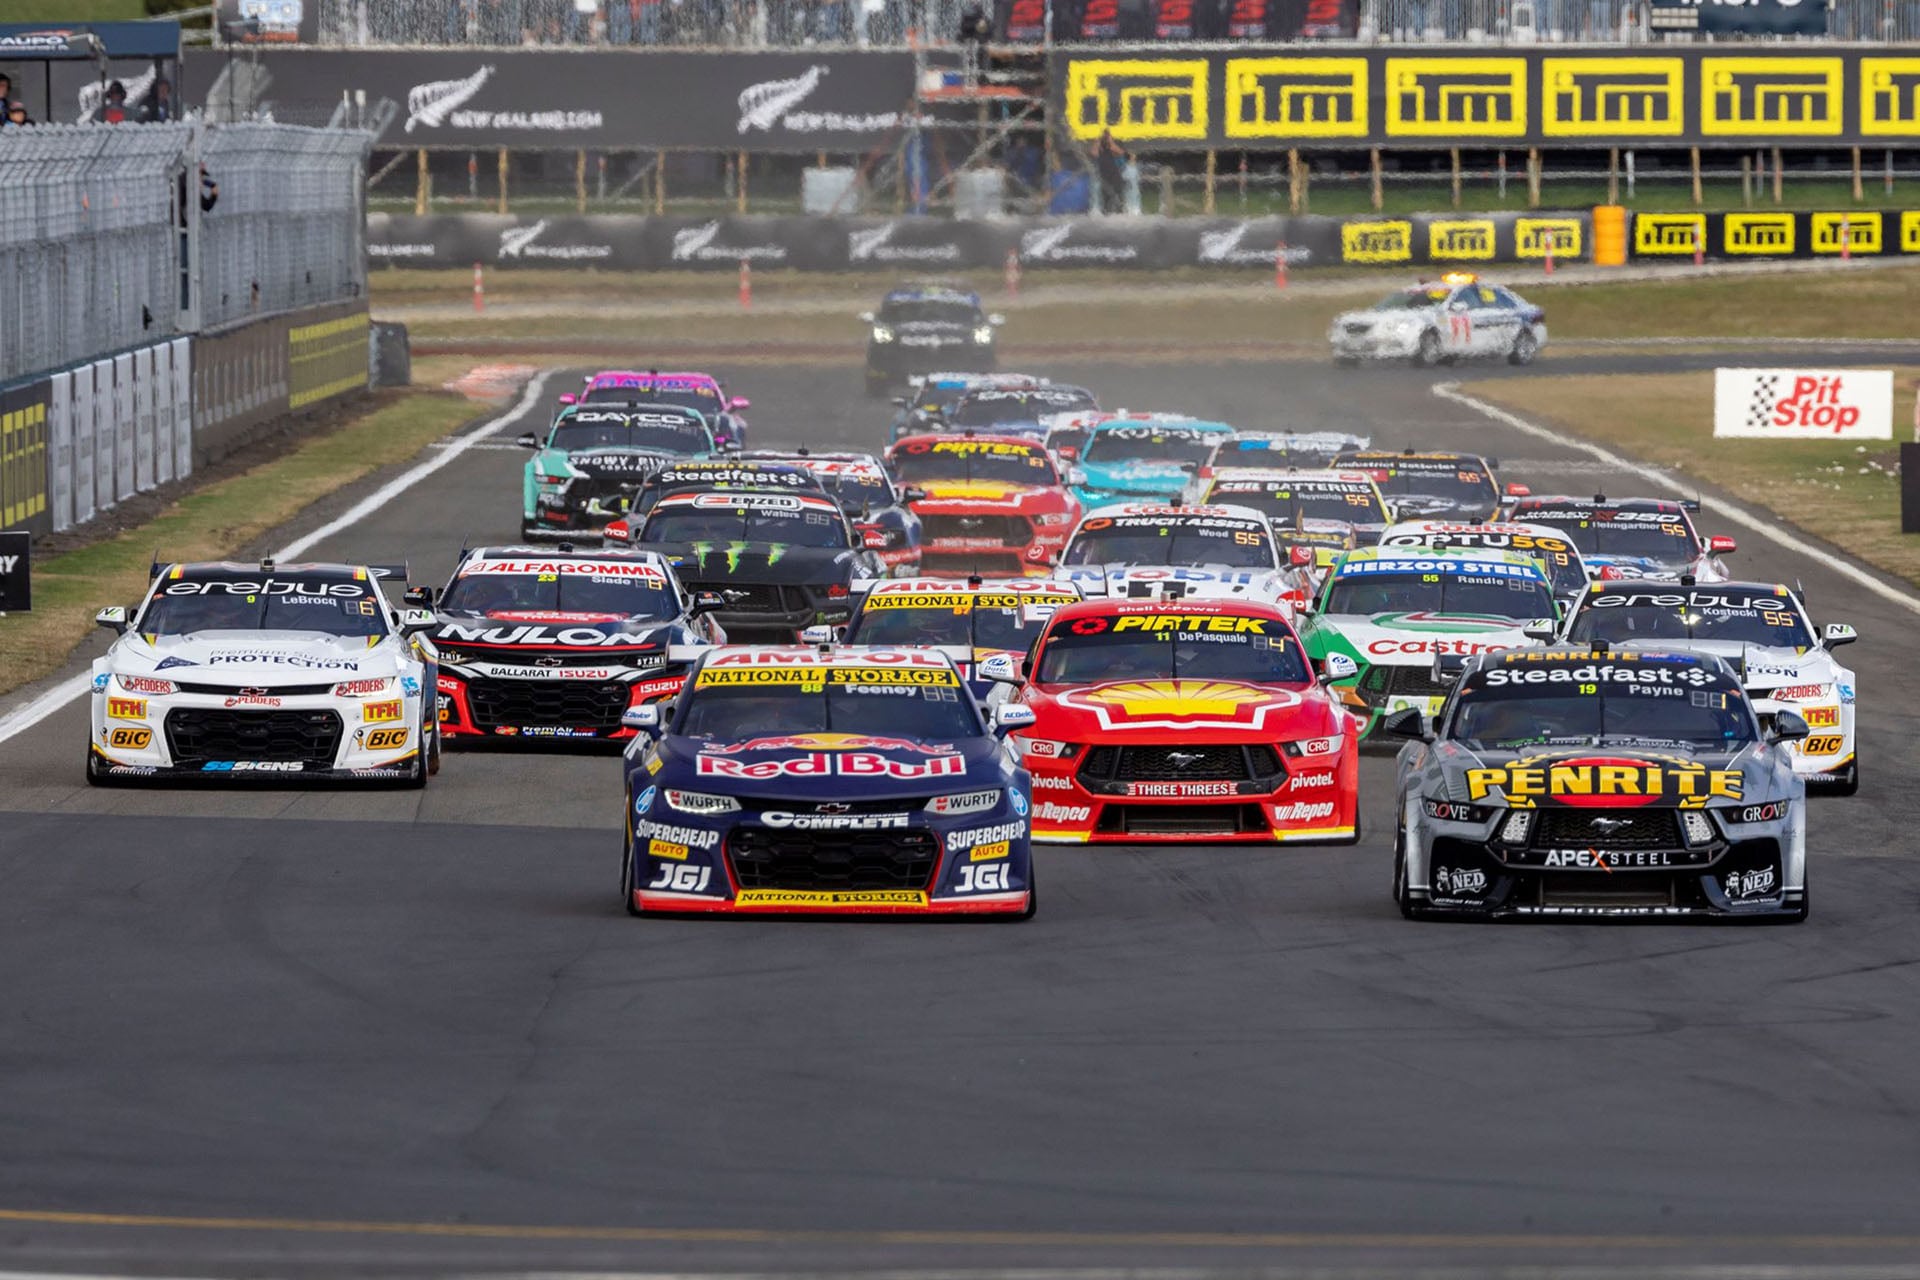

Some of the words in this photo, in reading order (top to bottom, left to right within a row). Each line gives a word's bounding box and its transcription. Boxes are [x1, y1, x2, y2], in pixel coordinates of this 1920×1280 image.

[0, 36, 63, 45] AUPO
[1791, 376, 1842, 405] Pit
[576, 412, 684, 424] DAYCO
[1773, 397, 1860, 433] Stop
[932, 442, 1031, 456] PIRTEK
[662, 469, 778, 483] Steadfast
[1267, 482, 1371, 494] BATTERIES
[731, 497, 792, 507] ENZED
[761, 509, 800, 519] Waters
[1116, 517, 1184, 528] TRUCK
[1185, 518, 1260, 531] ASSIST
[1661, 523, 1687, 537] 55
[1159, 528, 1168, 536] 2
[1234, 531, 1261, 546] 55
[489, 562, 664, 577] ALFAGOMMA
[1070, 568, 1252, 585] Mobil
[1343, 561, 1457, 574] HERZOG
[1463, 562, 1537, 578] STEEL
[537, 574, 558, 583] 23
[592, 575, 631, 586] Slade
[1422, 574, 1439, 583] 55
[1458, 576, 1504, 586] Randle
[166, 578, 364, 597] erebus
[247, 594, 256, 604] 9
[282, 595, 337, 607] LeBrocq
[869, 595, 968, 608] NATIONAL
[979, 595, 1074, 607] STORAGE
[1592, 592, 1785, 610] erebus
[1157, 605, 1222, 613] V-Power
[1703, 607, 1757, 618] Kostecki
[1113, 615, 1267, 634] PIRTEK
[1763, 610, 1794, 627] 55
[437, 624, 656, 646] NULON
[1155, 632, 1170, 641] 11
[1269, 637, 1285, 653] 4
[1368, 640, 1524, 655] Castro
[210, 655, 358, 671] PROTECTION
[712, 651, 944, 667] AMPOL
[1506, 651, 1638, 662] PENRITE
[491, 667, 552, 678] BALLARAT
[559, 670, 608, 678] ISUZU
[702, 669, 820, 683] NATIONAL
[833, 669, 947, 684] STORAGE
[1486, 665, 1673, 686] Steadfast
[134, 677, 171, 694] PEDDERS
[348, 679, 385, 693] PEDDERS
[641, 681, 678, 693] ISUZU
[801, 684, 824, 693] 88
[845, 684, 917, 697] Feeney
[1579, 684, 1597, 694] 19
[1629, 684, 1684, 697] Payne
[1786, 684, 1822, 698] PEDDERS
[110, 700, 140, 716] TFH
[237, 696, 281, 707] PEDDERS
[366, 701, 398, 718] TFH
[1805, 708, 1835, 723] TFH
[1032, 743, 1054, 753] CRC
[1308, 741, 1329, 752] CRC
[696, 753, 831, 779] Red
[837, 753, 966, 779] Bull
[1137, 784, 1177, 795] THREE
[1180, 784, 1228, 795] THREES
[1466, 766, 1744, 801] PENRITE
[1041, 802, 1090, 823] Repco
[1290, 802, 1334, 822] Repco
[1427, 801, 1470, 821] GROVE
[1743, 801, 1786, 822] GROVE
[636, 819, 719, 850] SUPERCHEAP
[947, 819, 1026, 851] SUPERCHEAP
[654, 843, 684, 856] AUTO
[974, 845, 1005, 857] AUTO
[1544, 849, 1609, 869] APEX
[1610, 853, 1671, 865] STEEL
[650, 863, 712, 891] JGI
[954, 863, 1010, 892] JGI
[1452, 872, 1485, 889] NED
[1742, 871, 1773, 891] NED
[742, 893, 829, 902] NATIONAL
[838, 892, 919, 903] STORAGE
